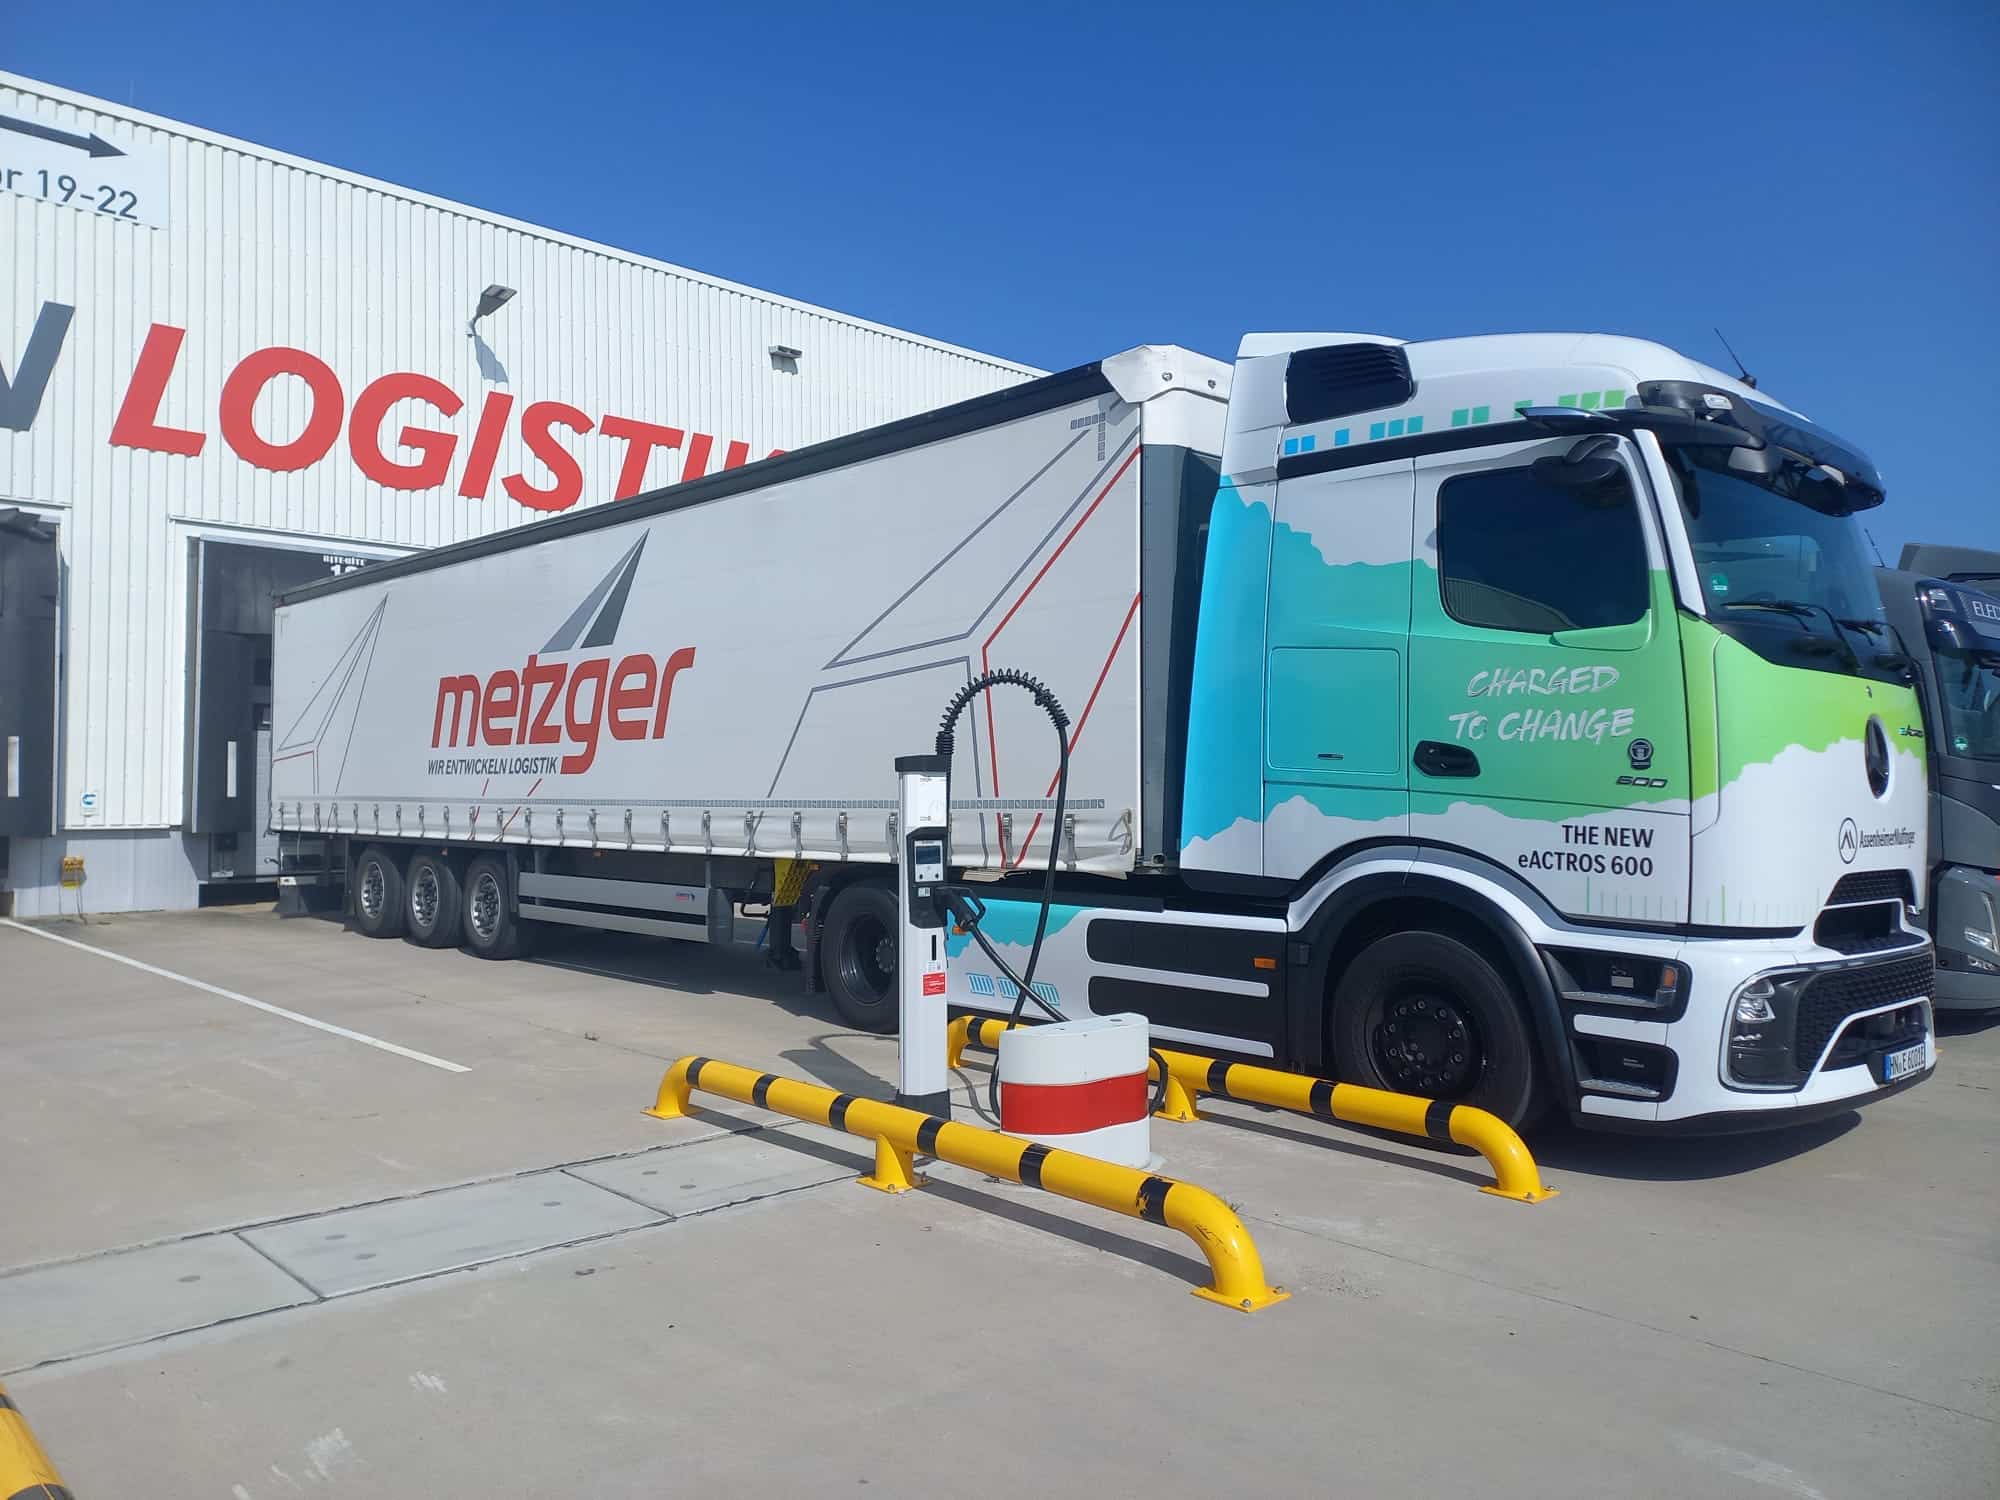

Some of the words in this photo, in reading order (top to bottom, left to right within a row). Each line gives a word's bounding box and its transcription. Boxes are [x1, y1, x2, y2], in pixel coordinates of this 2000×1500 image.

[38, 169, 138, 220] 19-22
[109, 323, 786, 512] LOGISTI
[1467, 666, 1620, 697] CHARGED
[431, 647, 696, 775] metzger
[1449, 710, 1488, 741] TO
[1497, 708, 1635, 744] CHANGE
[427, 759, 445, 776] WIR
[446, 757, 507, 776] ENTWICKELN
[508, 756, 560, 775] LOGISTIK
[1616, 775, 1668, 788] 600
[1562, 824, 1599, 846] THE
[1604, 827, 1654, 848] NEW
[1518, 850, 1606, 874] eACTROS
[1611, 855, 1653, 877] 600
